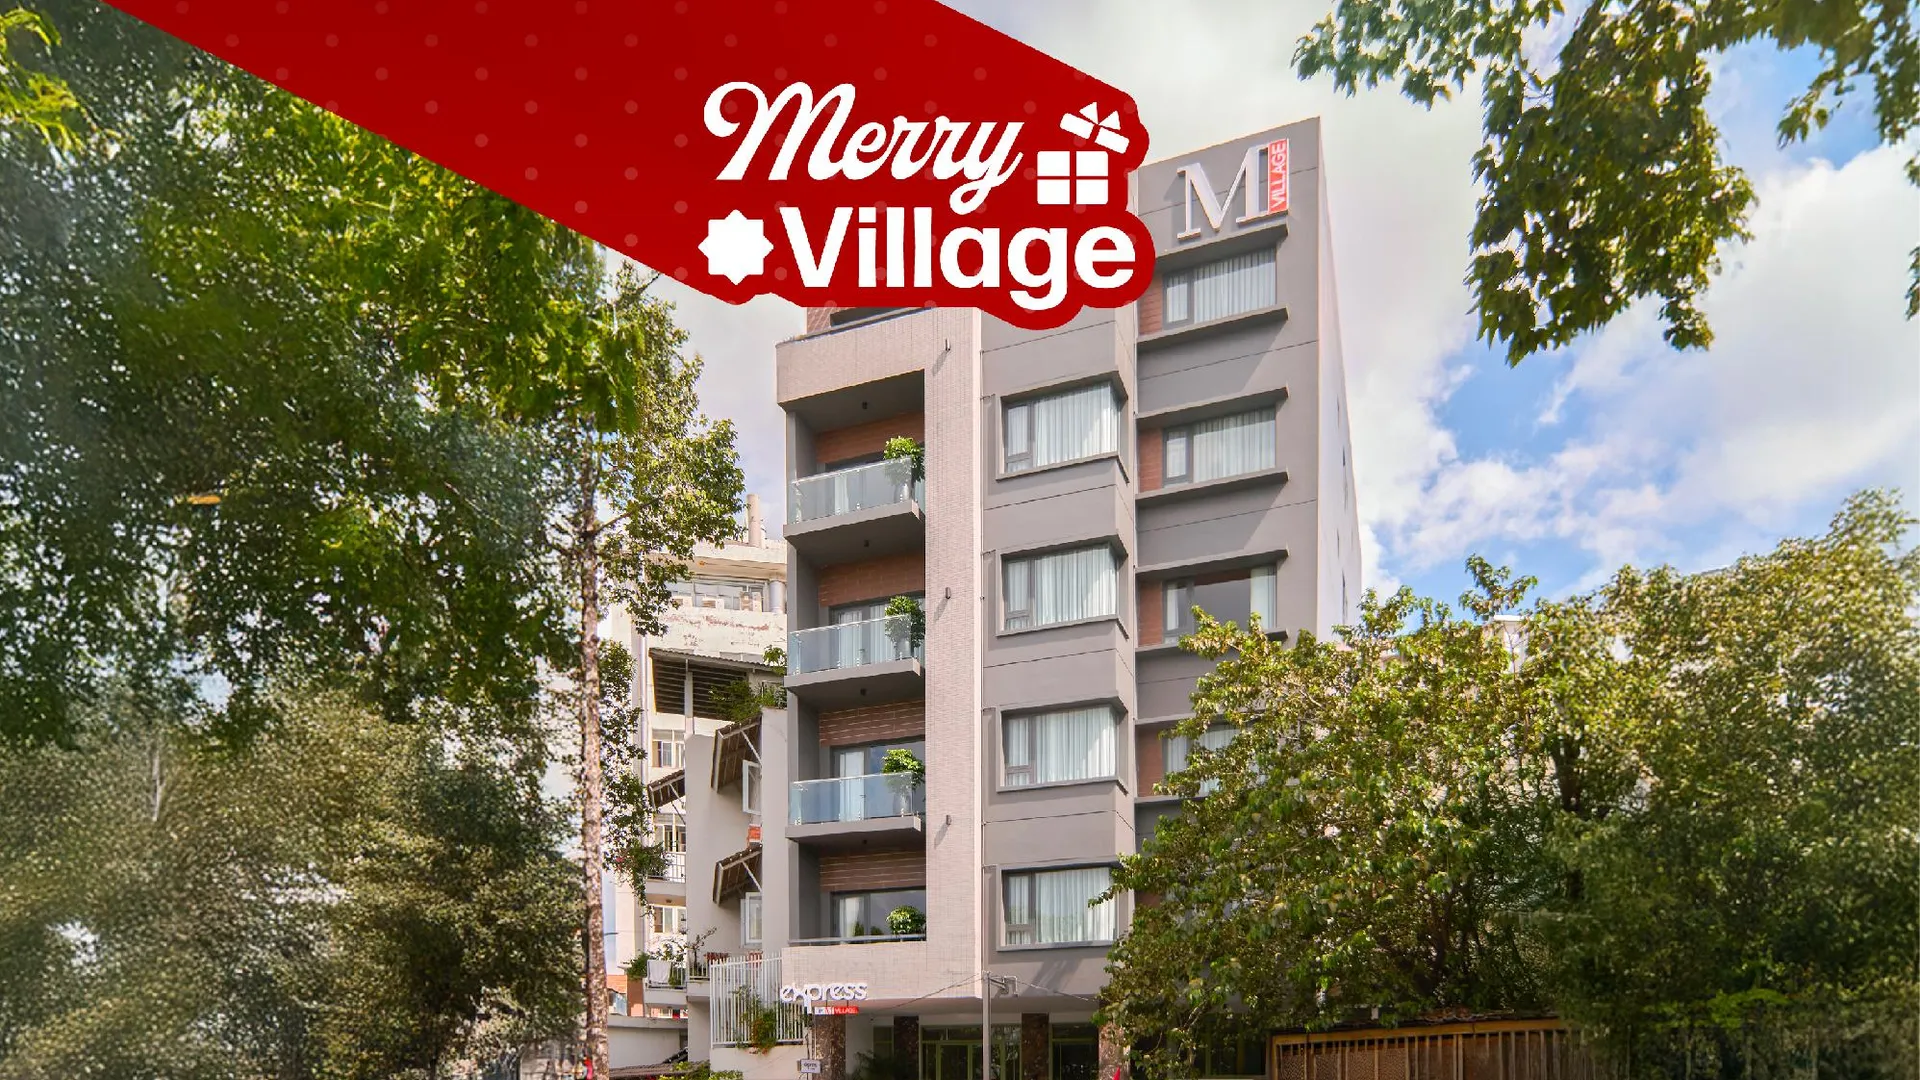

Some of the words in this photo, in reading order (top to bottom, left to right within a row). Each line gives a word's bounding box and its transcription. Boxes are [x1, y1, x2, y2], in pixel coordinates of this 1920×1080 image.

[1177, 146, 1268, 239] M
[1271, 143, 1286, 210] VILLAGE
[780, 983, 868, 1014] express
